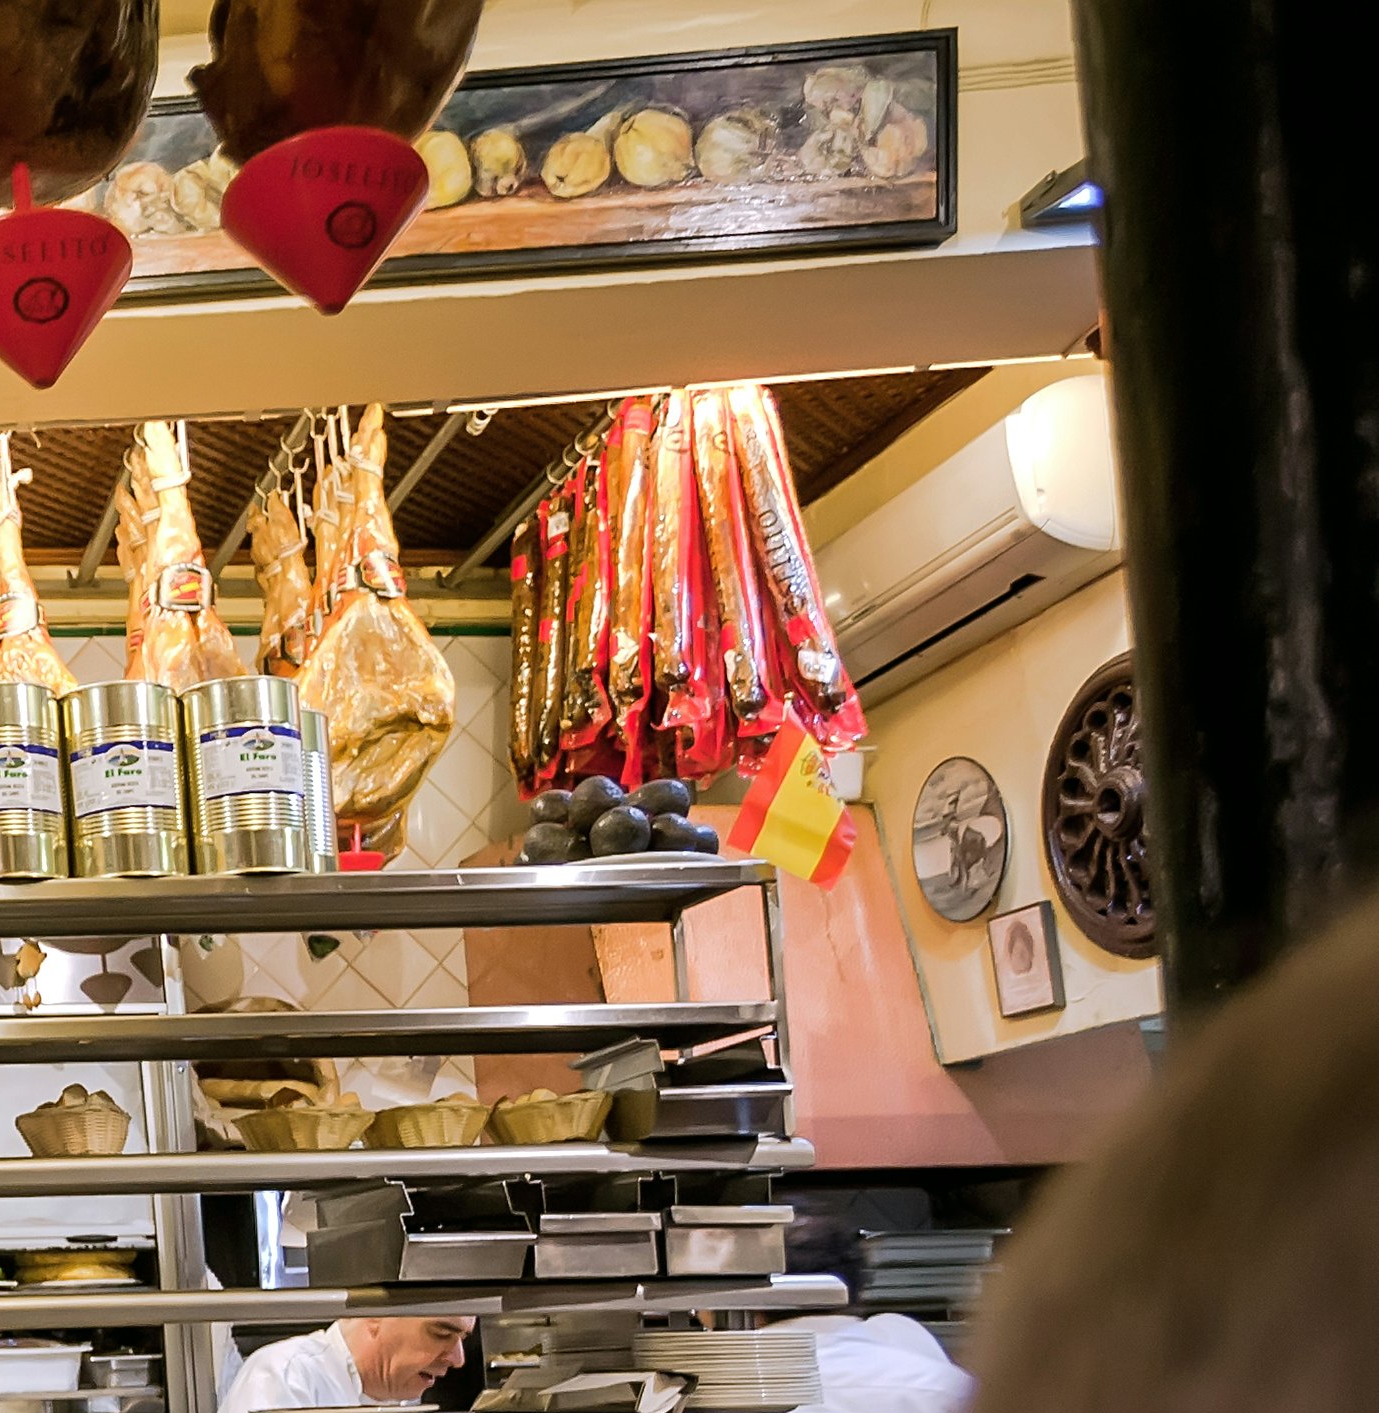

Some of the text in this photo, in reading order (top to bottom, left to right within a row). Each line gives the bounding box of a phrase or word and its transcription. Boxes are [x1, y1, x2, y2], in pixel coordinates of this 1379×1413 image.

[240, 752, 277, 762] El Faro
[4, 769, 29, 779] Faro
[105, 767, 143, 779] El Faro
